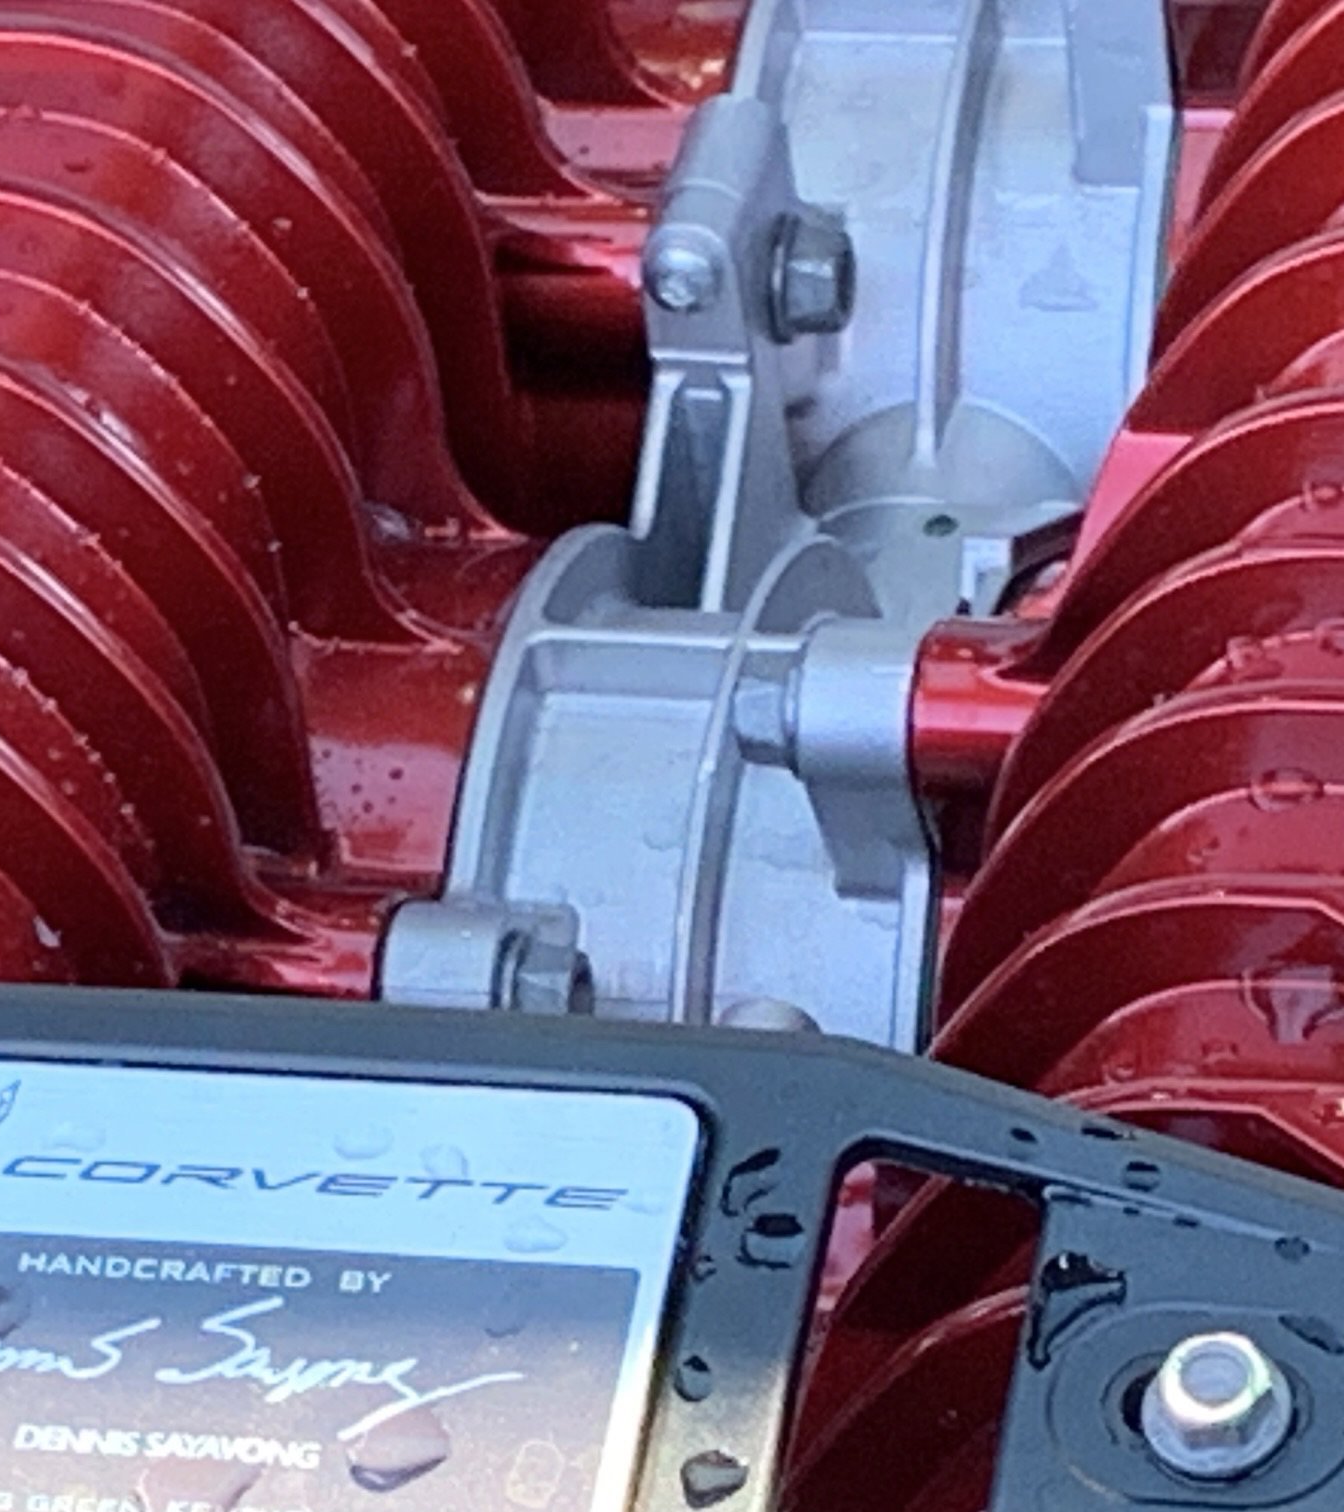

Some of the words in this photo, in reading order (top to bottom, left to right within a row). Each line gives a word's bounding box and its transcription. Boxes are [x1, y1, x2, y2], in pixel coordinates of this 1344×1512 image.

[0, 1154, 630, 1211] CORVETTE
[17, 1251, 312, 1288] HANDCRAFTED
[338, 1269, 394, 1294] BY
[13, 1422, 142, 1458] DENNIS
[142, 1430, 323, 1470] SAYAVONG
